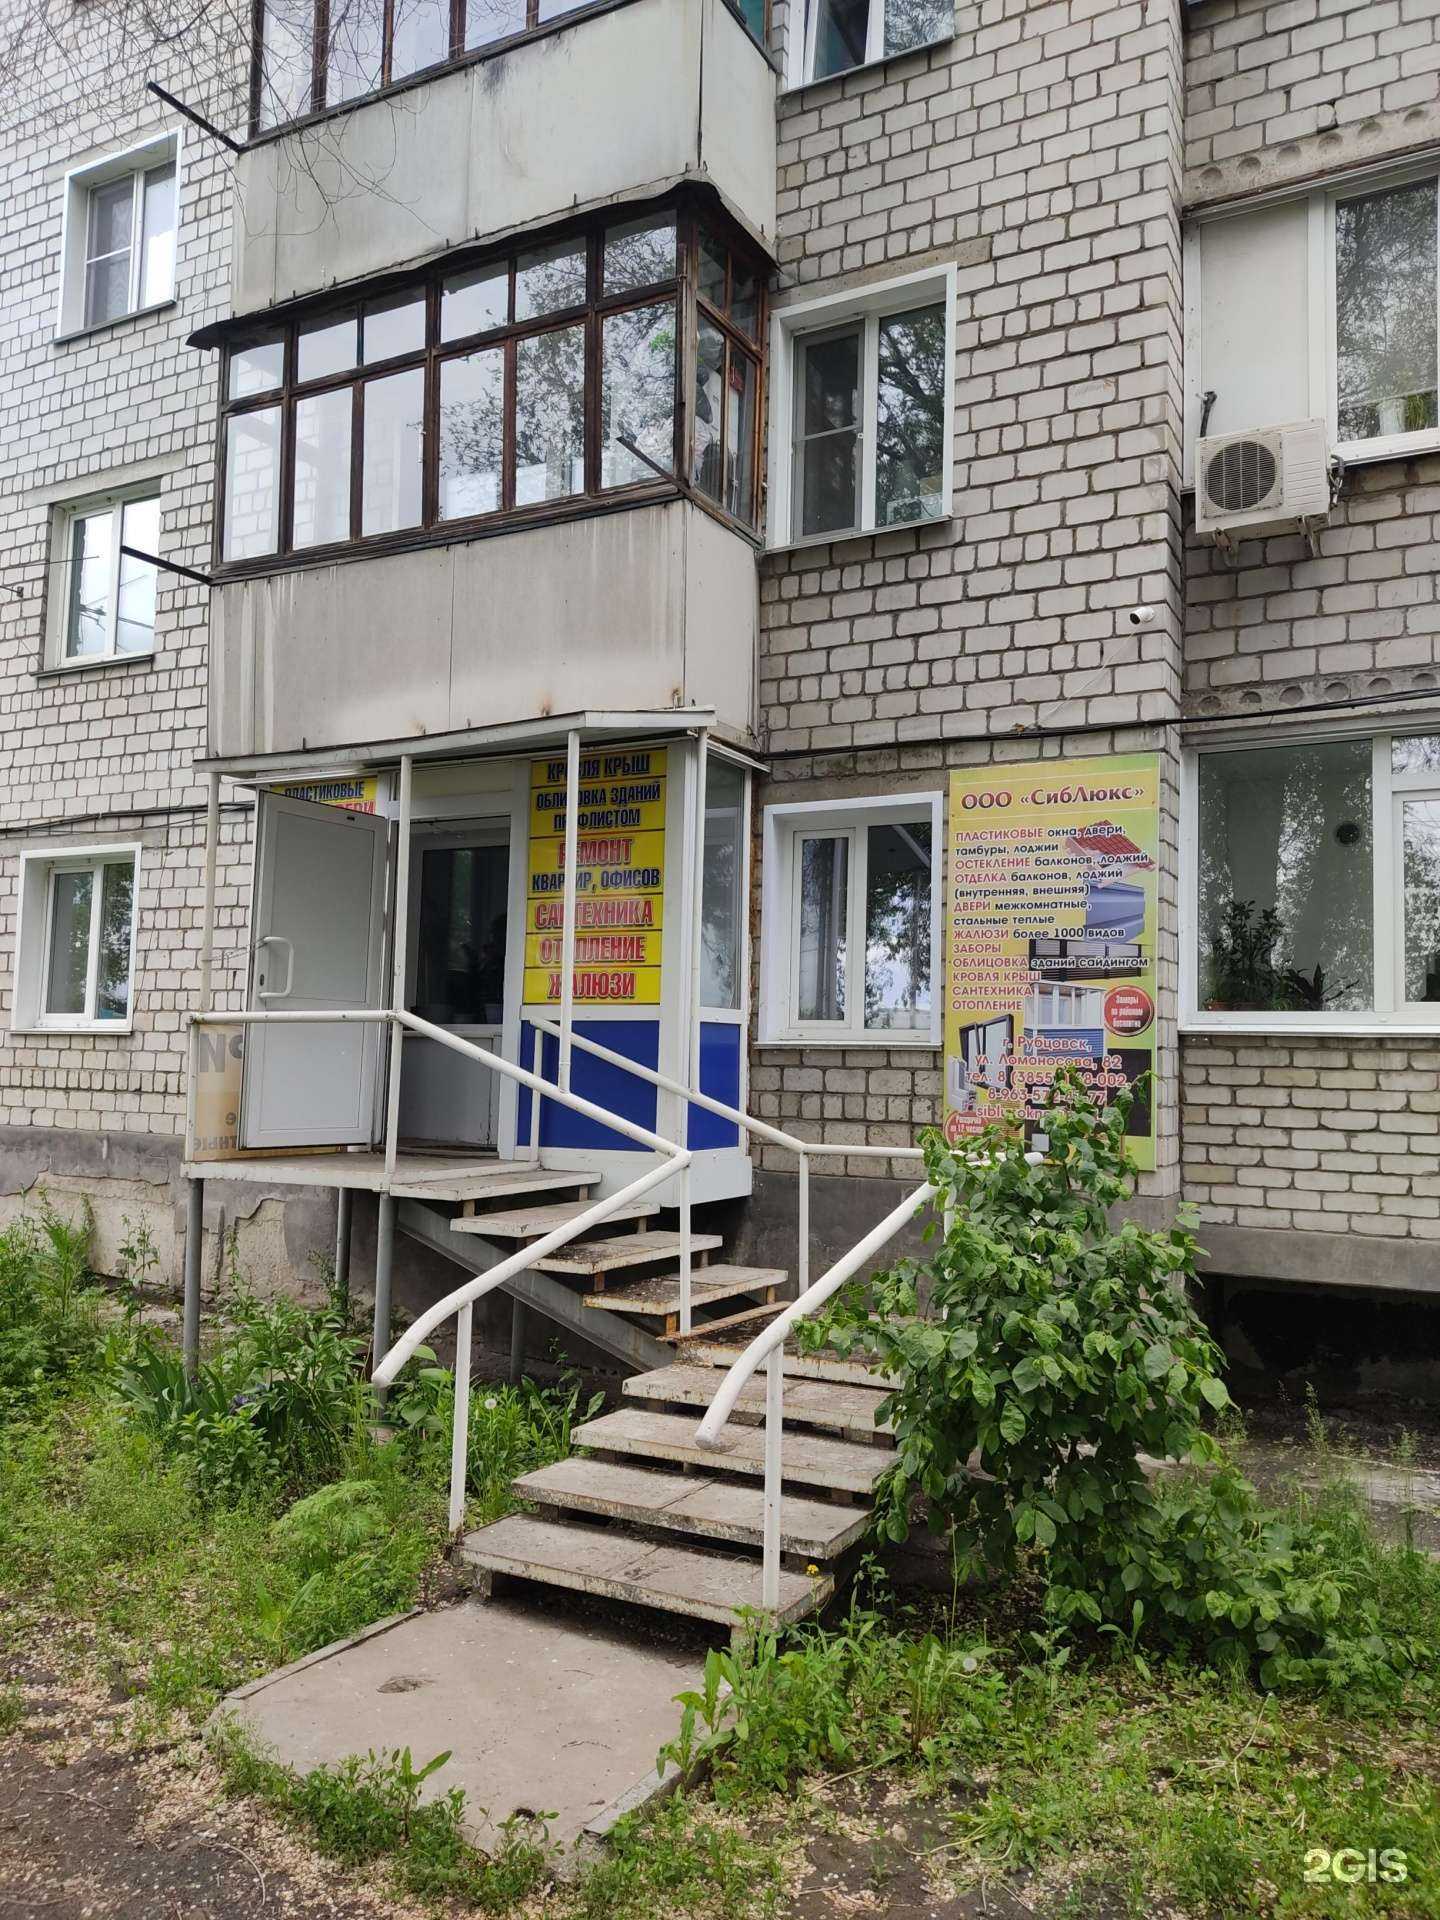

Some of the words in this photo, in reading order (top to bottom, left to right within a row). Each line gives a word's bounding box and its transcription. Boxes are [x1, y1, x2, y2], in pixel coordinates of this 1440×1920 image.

[548, 759, 599, 781] КРЛЯ
[604, 754, 650, 776] КРЫШ
[536, 787, 607, 811] ОБЛИОВКА
[611, 781, 661, 807] ЗДАНИЙ
[961, 790, 1012, 810] ООО
[1020, 786, 1145, 806] «СибЛюкс»
[553, 808, 641, 832] ПРФЛИСТОМ
[956, 828, 1043, 842] ПЛАСТИКОВЫЕ
[1047, 829, 1082, 838] окна,
[1085, 826, 1126, 837] двери,
[956, 845, 1010, 857] тамбуры,
[1014, 842, 1059, 854] лоджии
[955, 858, 1030, 869] ОСТЕКЛЕНИЕ
[1034, 856, 1096, 867] балконов,
[532, 872, 596, 895] КВАРИР,
[600, 868, 660, 888] ОФИСОВ
[955, 873, 1007, 885] ОТДЕЛКА
[1011, 870, 1072, 882] балконов,
[1076, 868, 1123, 881] лоджий
[954, 887, 1028, 900] (внутренняя,
[1033, 884, 1091, 896] внешняя)
[954, 902, 991, 913] ДВЕРИ
[995, 900, 1092, 911] межкомнатные,
[954, 916, 1008, 926] стальные
[1013, 915, 1055, 925] теплые
[954, 929, 1009, 940] ЖАЛЮЗИ
[1013, 928, 1049, 939] более
[1054, 928, 1084, 938] 1000
[1088, 929, 1125, 939] видов
[540, 936, 647, 964] ОТПЛЕНИЕ
[953, 943, 1001, 954] ЗАБОРЫ
[953, 957, 1028, 969] ОБЛИЦОВКА
[1031, 956, 1075, 968] зданий
[1079, 956, 1148, 969] сайдингом
[953, 971, 1000, 982] КРОВЛЯ
[1004, 971, 1041, 982] КРЫШ
[953, 985, 1033, 997] САНТЕХНИКА
[953, 1000, 1023, 1010] ОТОПЛЕНИЕ
[1017, 1036, 1093, 1052] Рубцовск,
[975, 1055, 993, 1067] ул.
[998, 1054, 1097, 1070] Ломоносова,
[1102, 1056, 1122, 1069] 82
[966, 1070, 993, 1082] тел.
[997, 1071, 1006, 1082] 8
[1010, 1070, 1070, 1087] (3855)
[1075, 1072, 1131, 1088] 8-002,
